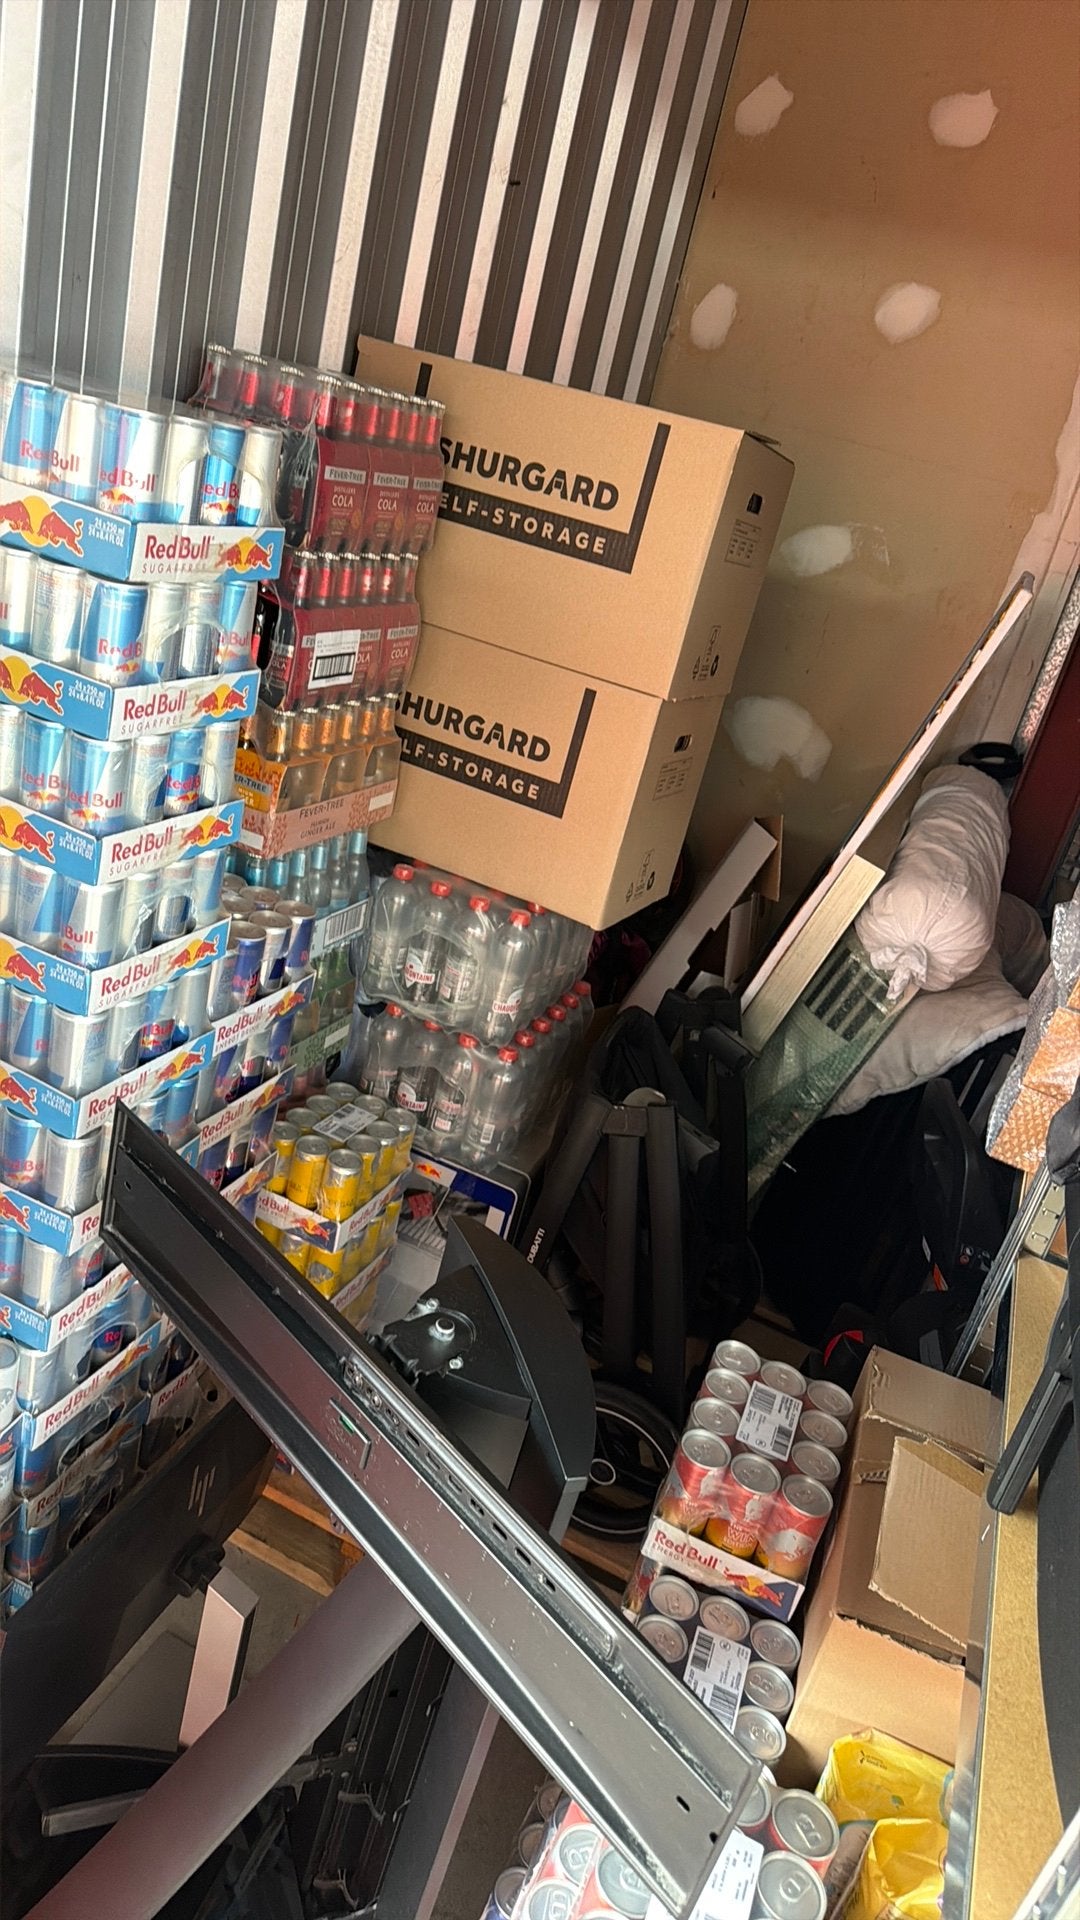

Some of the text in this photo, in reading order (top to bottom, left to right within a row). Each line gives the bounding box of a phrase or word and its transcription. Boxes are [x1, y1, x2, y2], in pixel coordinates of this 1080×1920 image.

[439, 436, 619, 512] SHURGARD
[332, 494, 353, 508] COLA
[377, 498, 398, 512] COLA
[416, 502, 434, 514] COLA
[438, 492, 606, 555] ELF-STORAGE
[390, 648, 409, 660] COLA
[399, 737, 539, 801] LF-STORAGE
